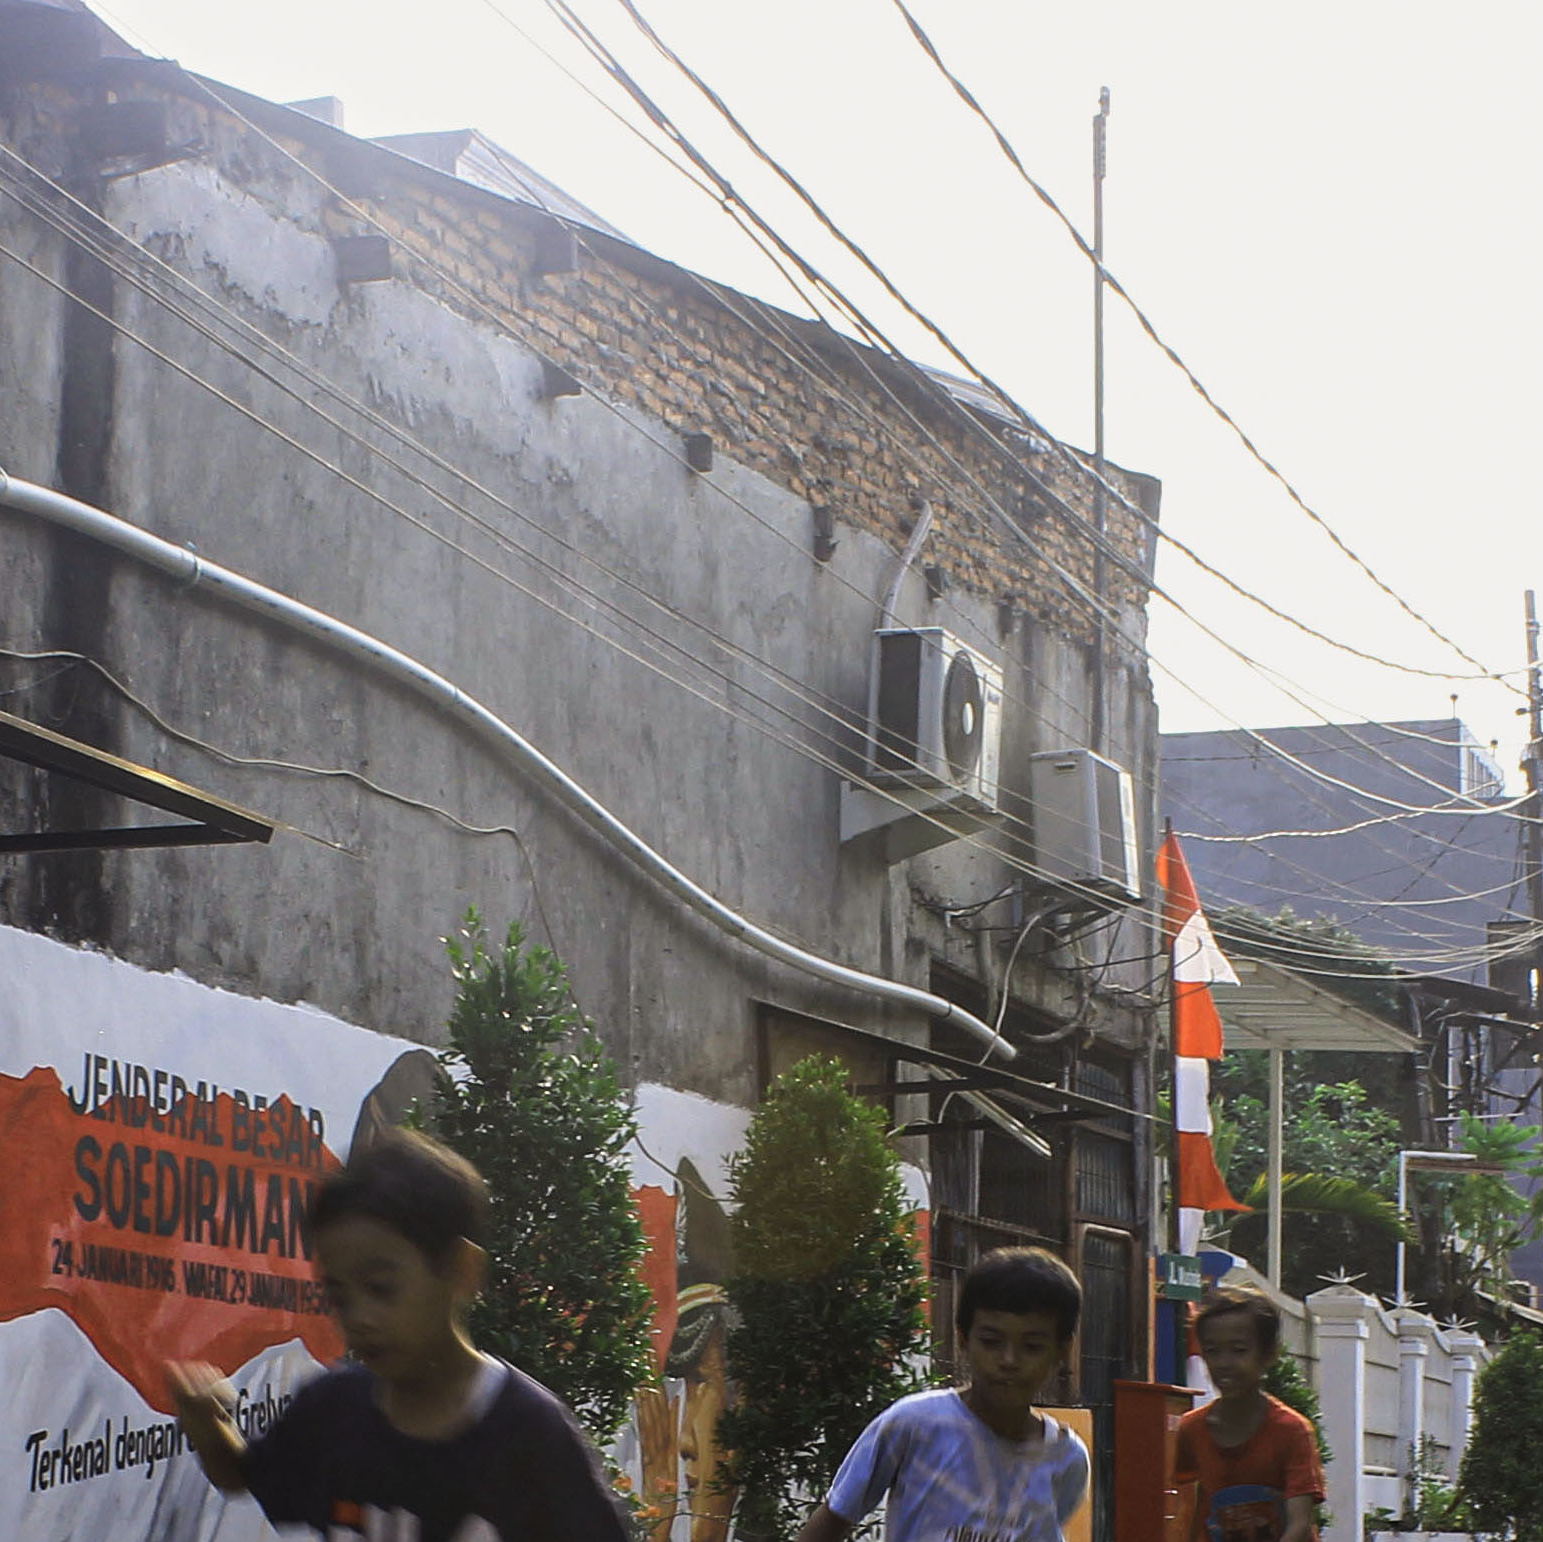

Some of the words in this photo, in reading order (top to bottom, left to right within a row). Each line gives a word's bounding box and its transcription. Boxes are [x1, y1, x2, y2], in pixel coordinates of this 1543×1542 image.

[67, 1052, 224, 1147] JENDERAL
[232, 1087, 325, 1172] BESAR
[73, 1134, 316, 1263] SOEDIRMAN
[25, 1418, 112, 1493] Terkenal
[115, 1415, 176, 1480] dengan
